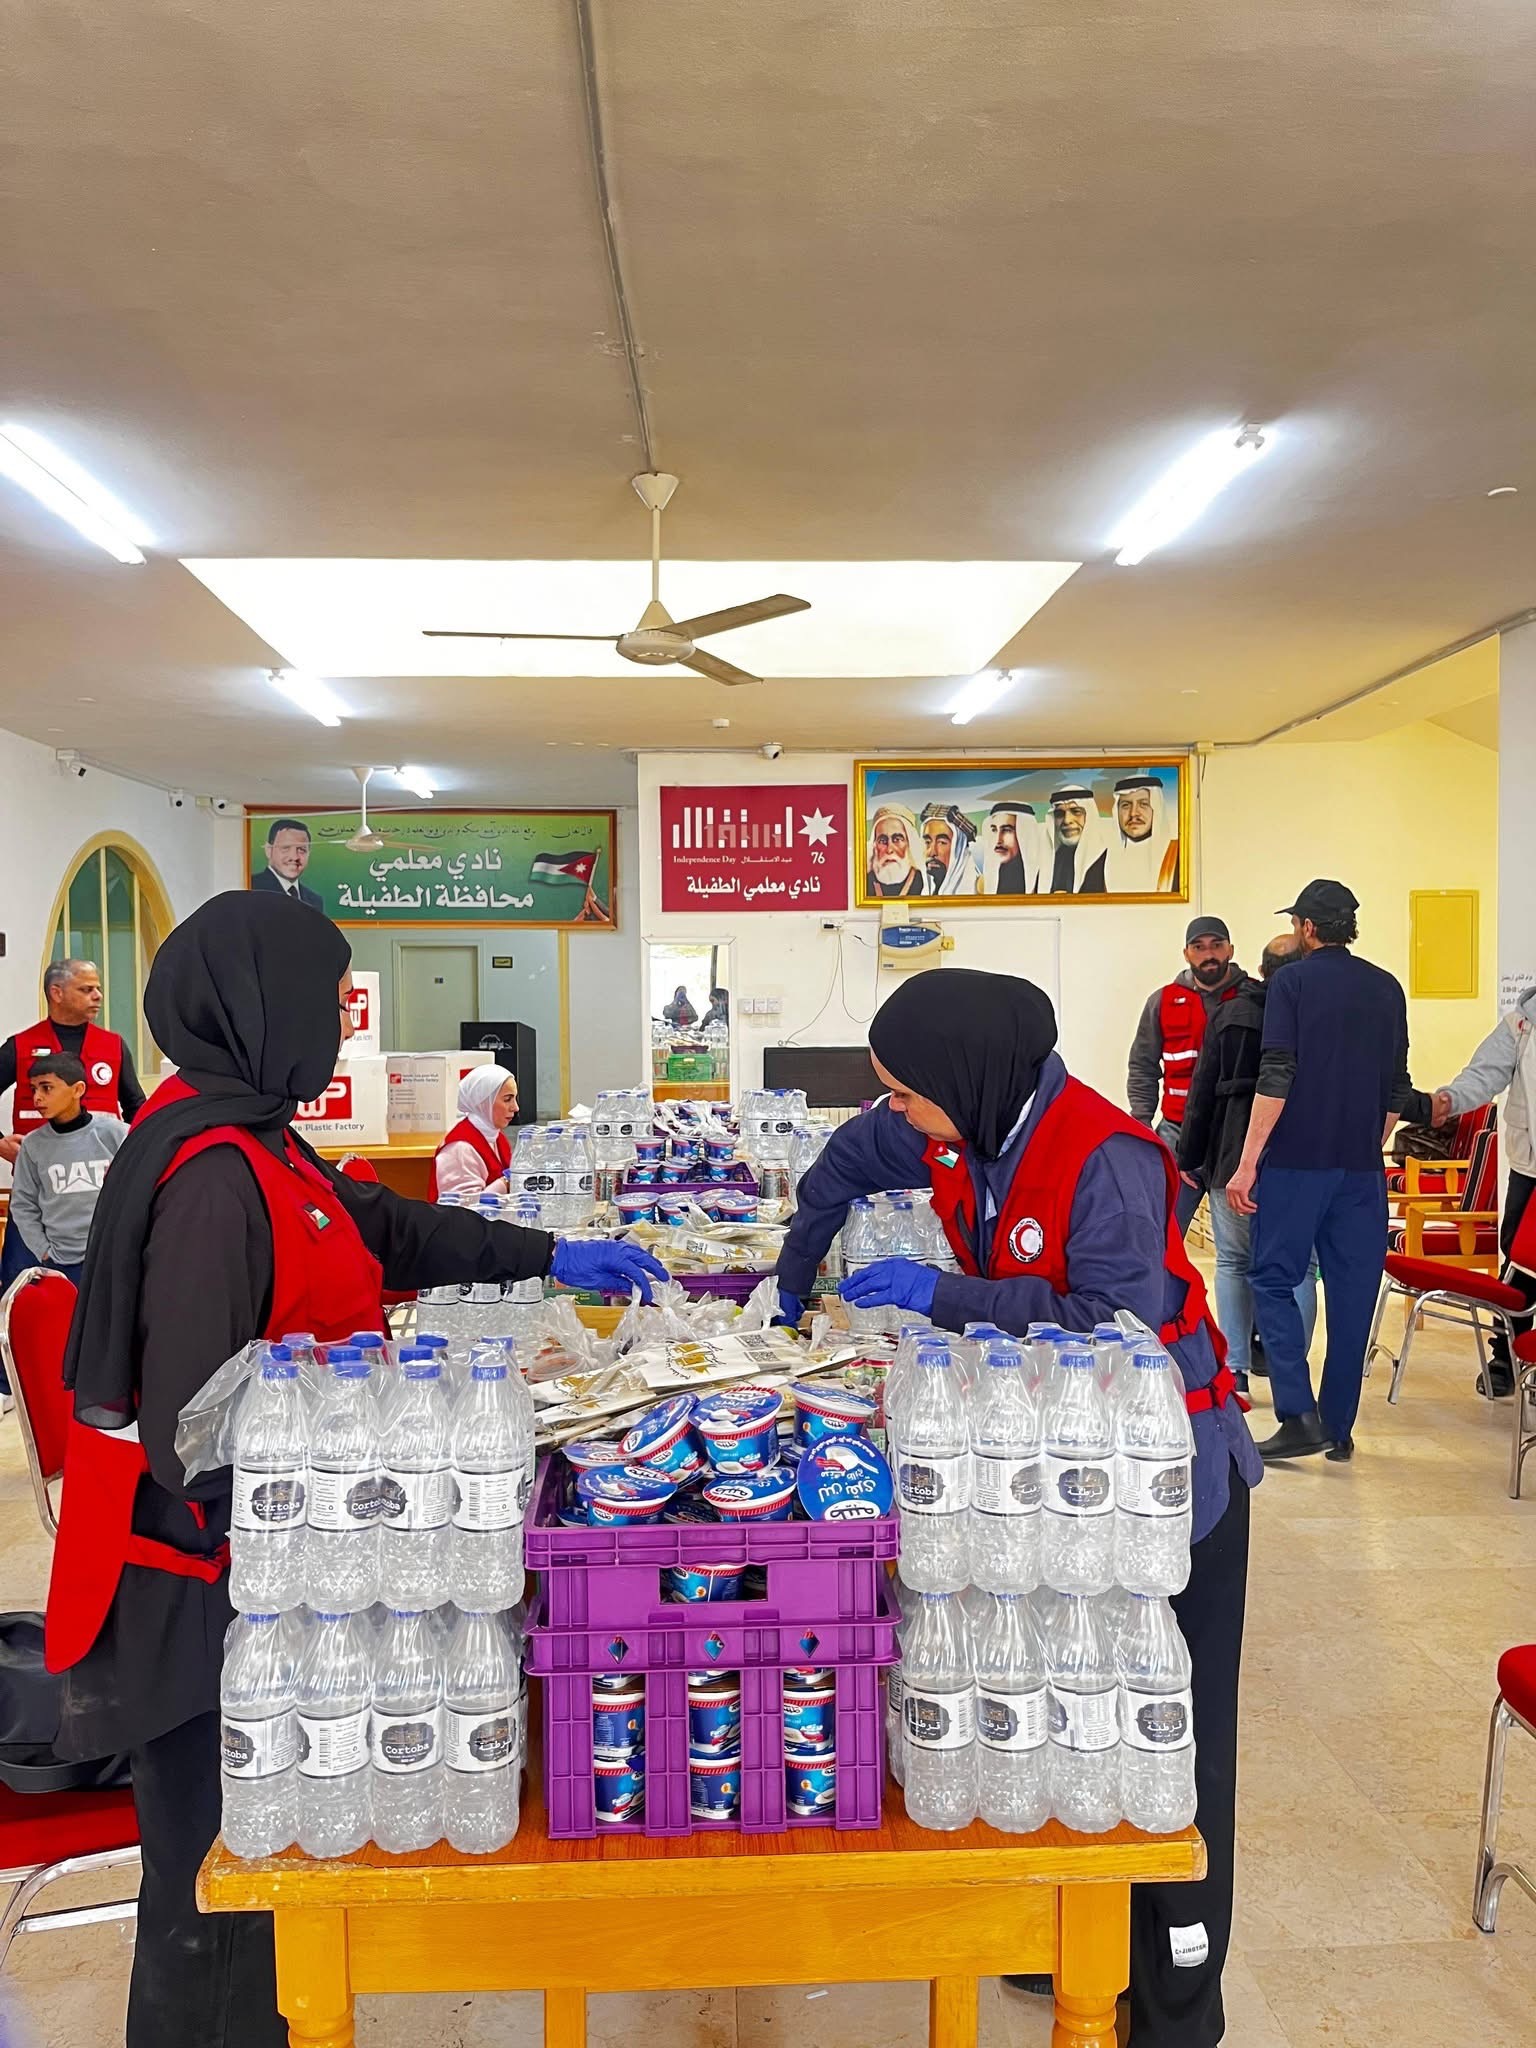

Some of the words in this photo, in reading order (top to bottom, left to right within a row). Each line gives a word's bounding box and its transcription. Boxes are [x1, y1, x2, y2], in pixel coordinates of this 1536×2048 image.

[369, 848, 443, 882] معلمي
[447, 848, 502, 880] نادي
[673, 855, 721, 865] Independence
[722, 856, 736, 865] Day
[810, 851, 826, 865] 76
[338, 883, 430, 915] الطفيلة
[435, 884, 534, 909] محافظة
[686, 875, 741, 899] الطفيلة
[743, 875, 786, 901] معلمي
[788, 875, 821, 899] نادي
[305, 1123, 332, 1131] Plastic
[335, 1122, 364, 1131] Factory
[48, 1159, 110, 1194] CAT
[818, 1482, 843, 1503] لبن
[845, 1475, 877, 1500] بقري
[901, 1482, 938, 1496] Cortoba
[1067, 1484, 1104, 1499] قرطبة
[256, 1499, 301, 1512] Cortoba
[1146, 1718, 1183, 1734] قرطبة
[385, 1743, 430, 1755] Cortoba
